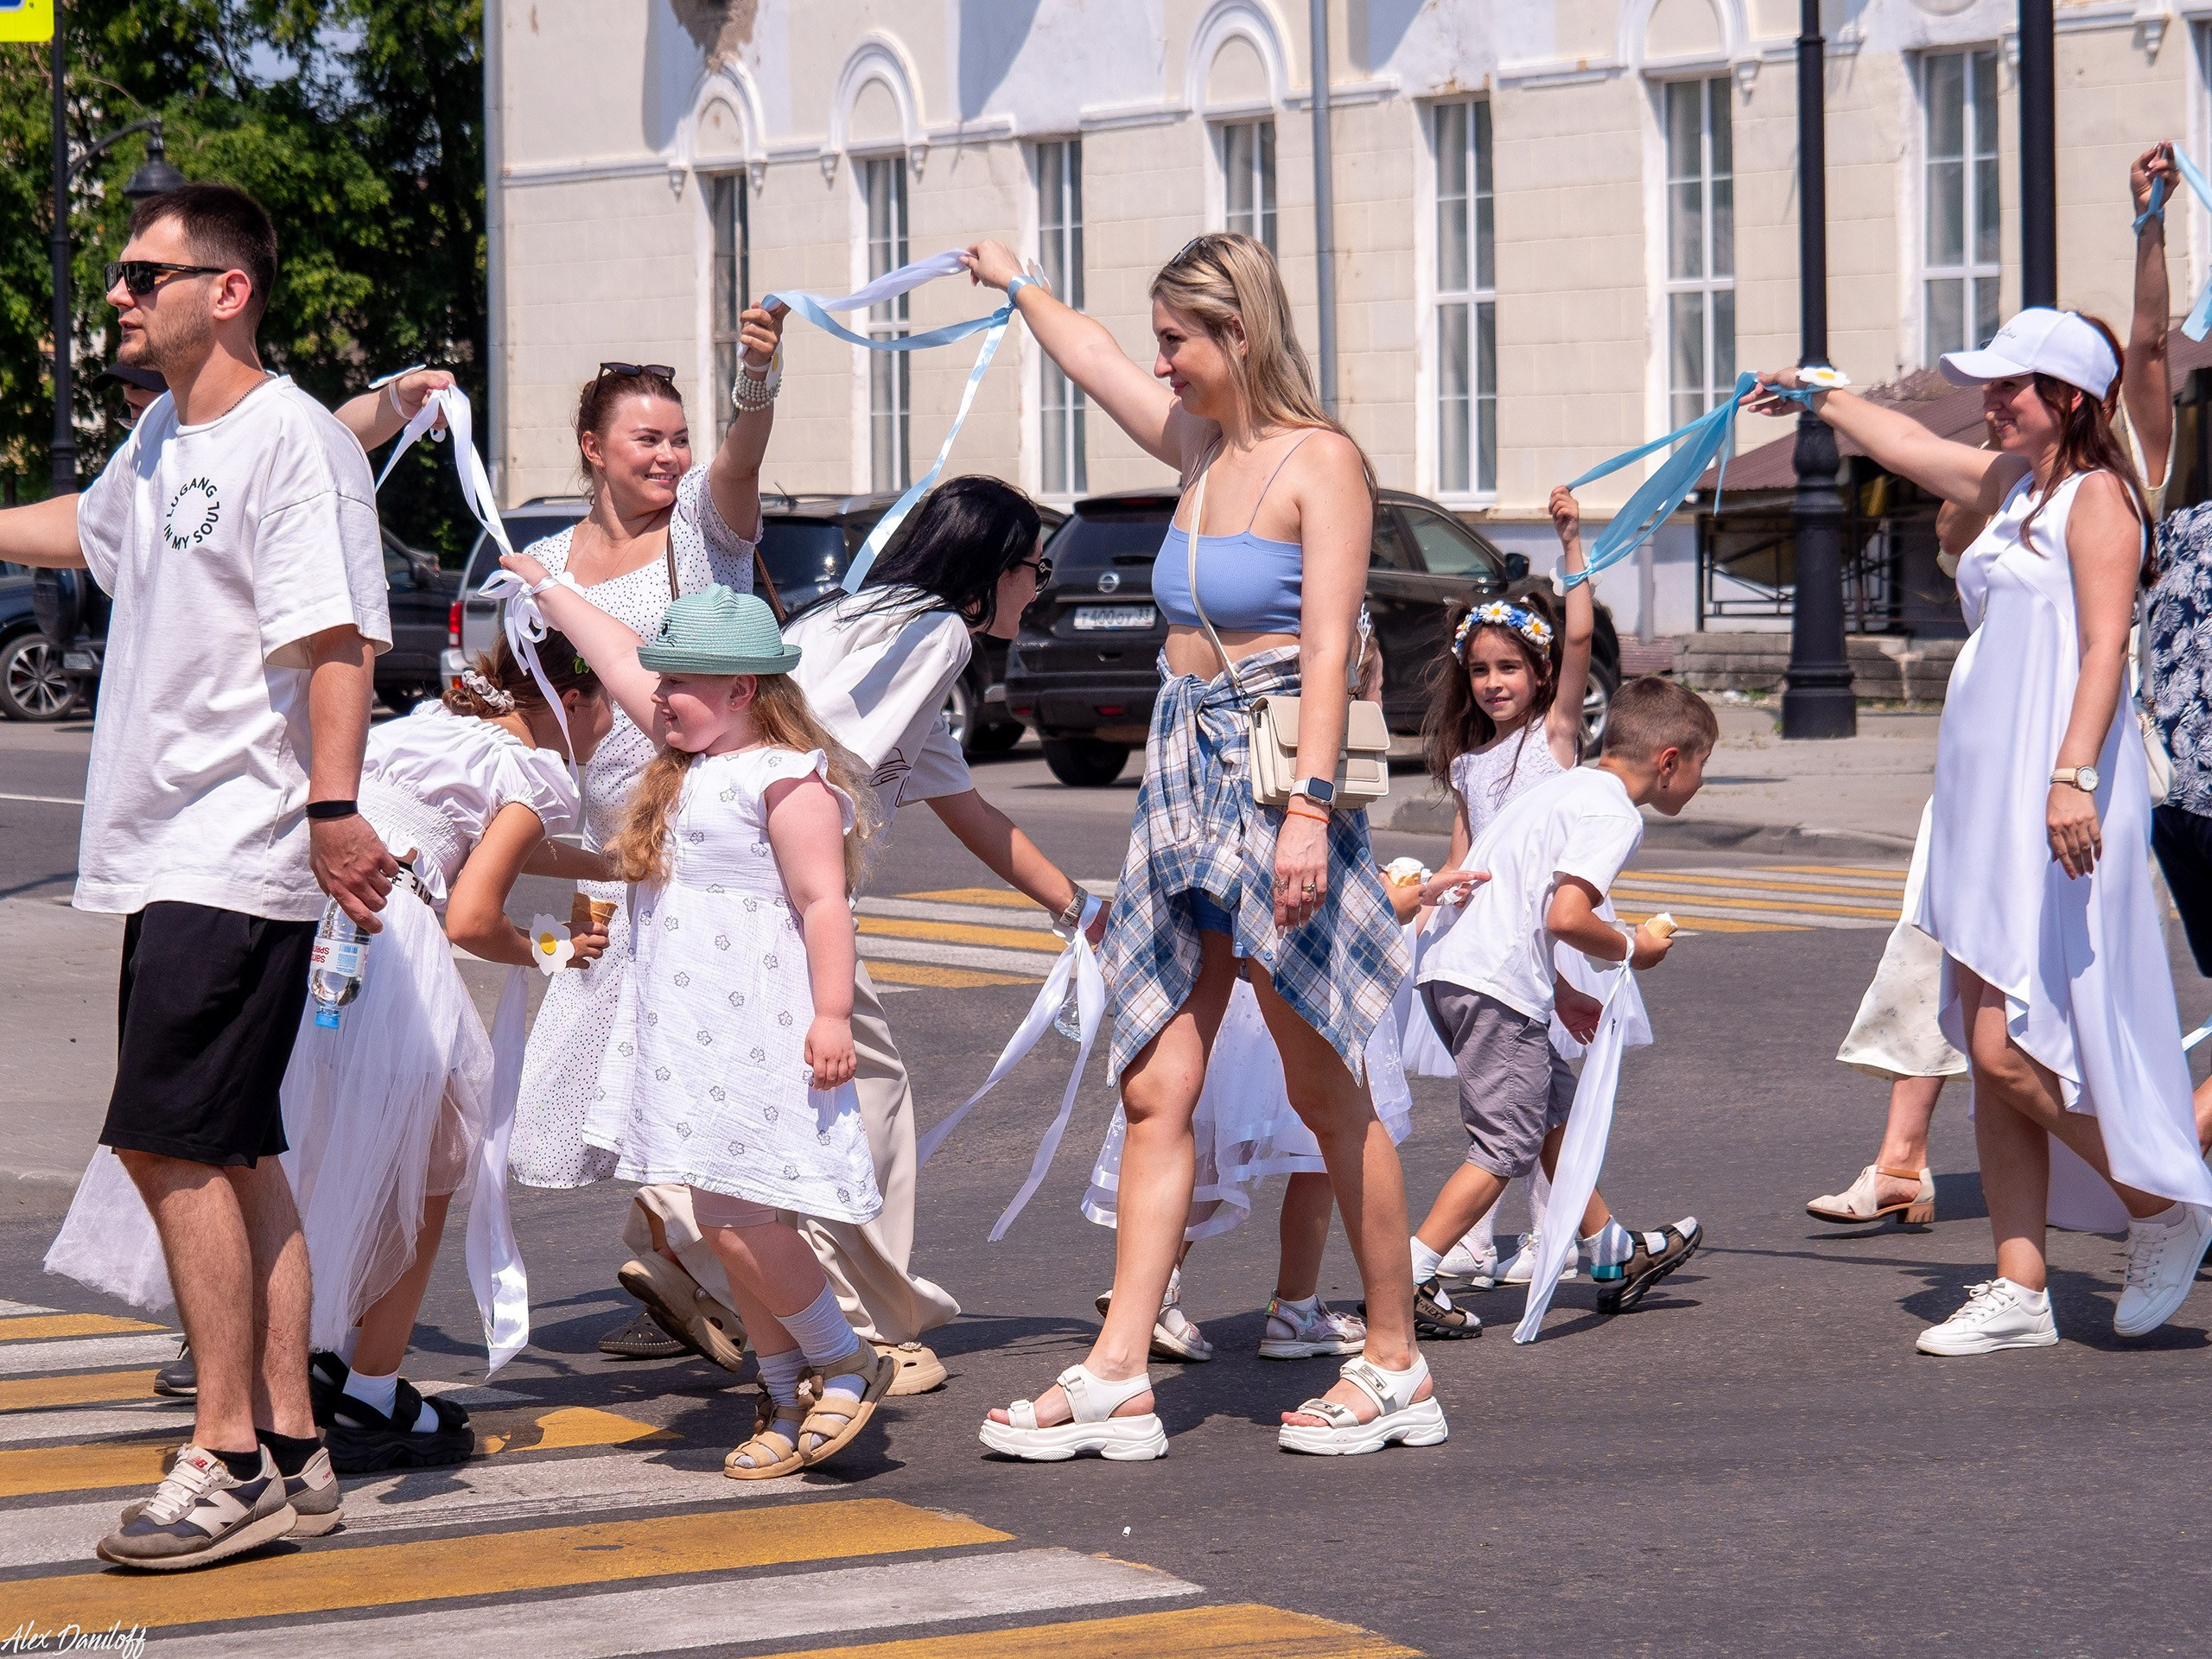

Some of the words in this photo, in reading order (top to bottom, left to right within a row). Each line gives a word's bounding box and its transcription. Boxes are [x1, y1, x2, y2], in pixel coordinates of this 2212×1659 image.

[164, 524, 173, 542] IN
[172, 536, 190, 550] MY
[193, 501, 219, 543] SOUL
